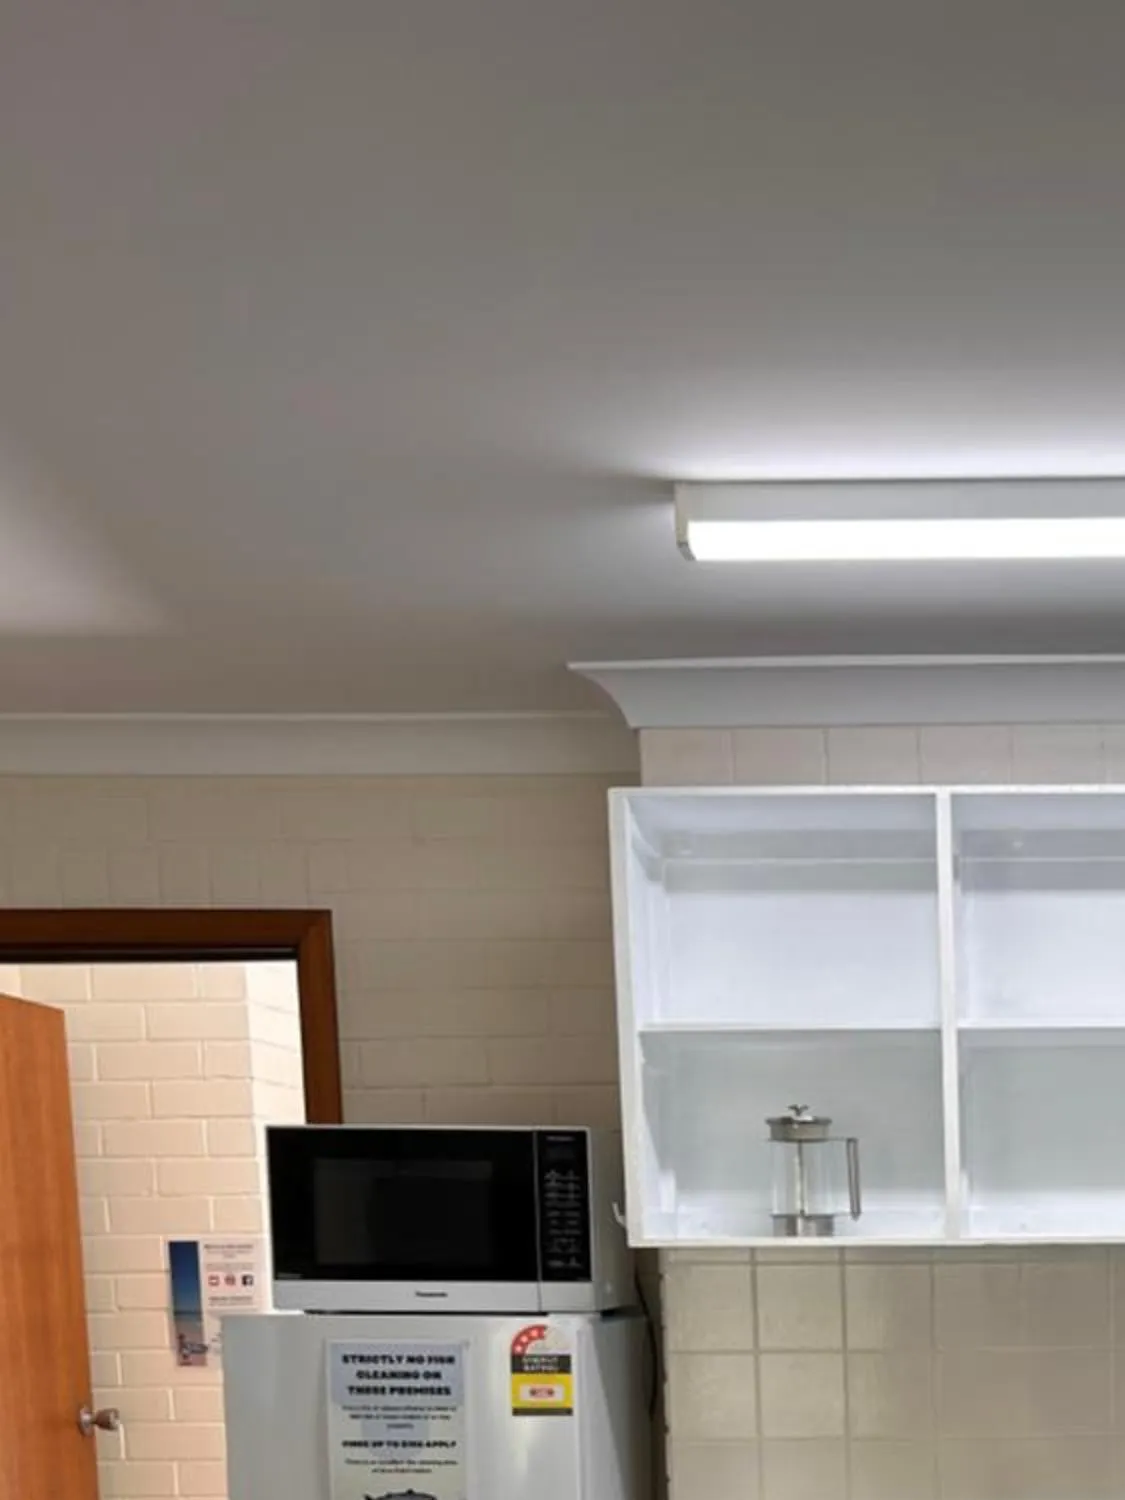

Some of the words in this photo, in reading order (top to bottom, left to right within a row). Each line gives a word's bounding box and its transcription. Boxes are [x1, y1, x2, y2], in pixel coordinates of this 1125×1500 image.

[341, 1353, 404, 1365] STRICTLY
[406, 1354, 425, 1365] NO
[427, 1354, 455, 1365] FISH
[355, 1369, 420, 1380] CLEANING
[422, 1369, 442, 1380] ON
[347, 1385, 386, 1396] THESE
[388, 1385, 452, 1397] PREMISES
